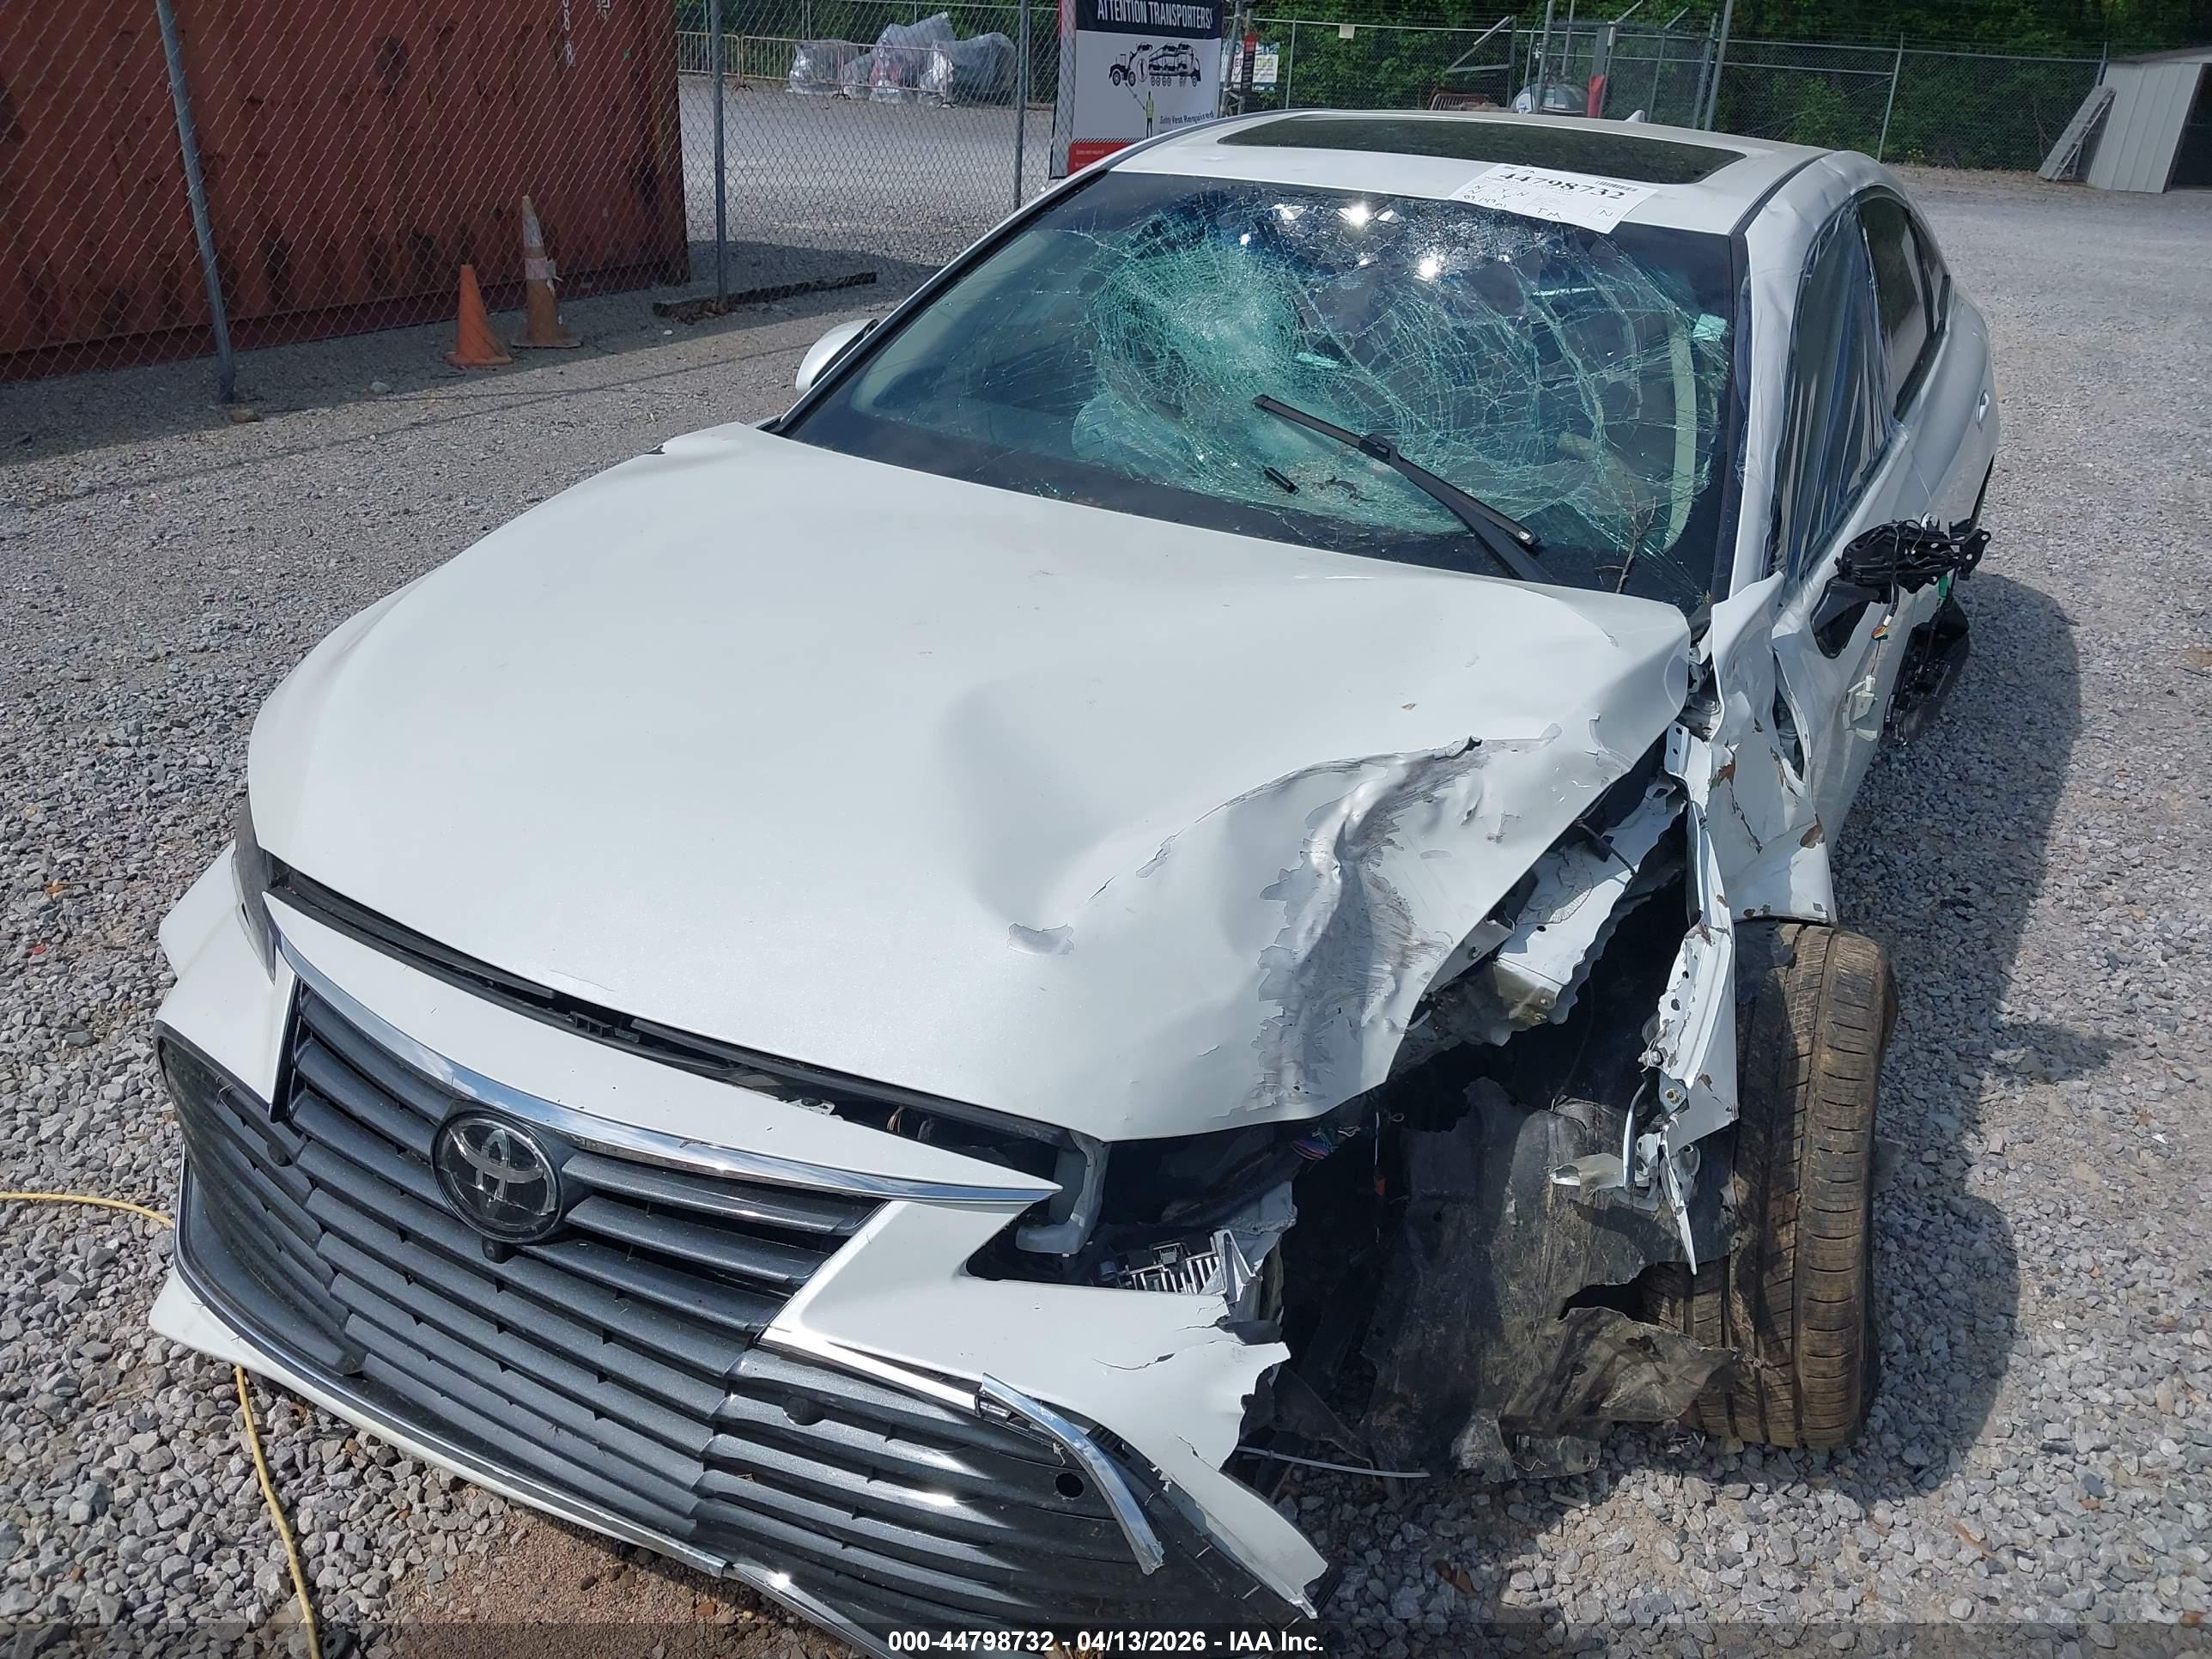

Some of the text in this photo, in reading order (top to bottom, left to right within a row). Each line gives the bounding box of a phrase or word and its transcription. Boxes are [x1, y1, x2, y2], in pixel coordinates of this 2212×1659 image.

[1097, 0, 1212, 28] ATTENTION TRANSPORTERS!
[1183, 110, 1214, 124] Required
[1498, 173, 1626, 199] 44798732
